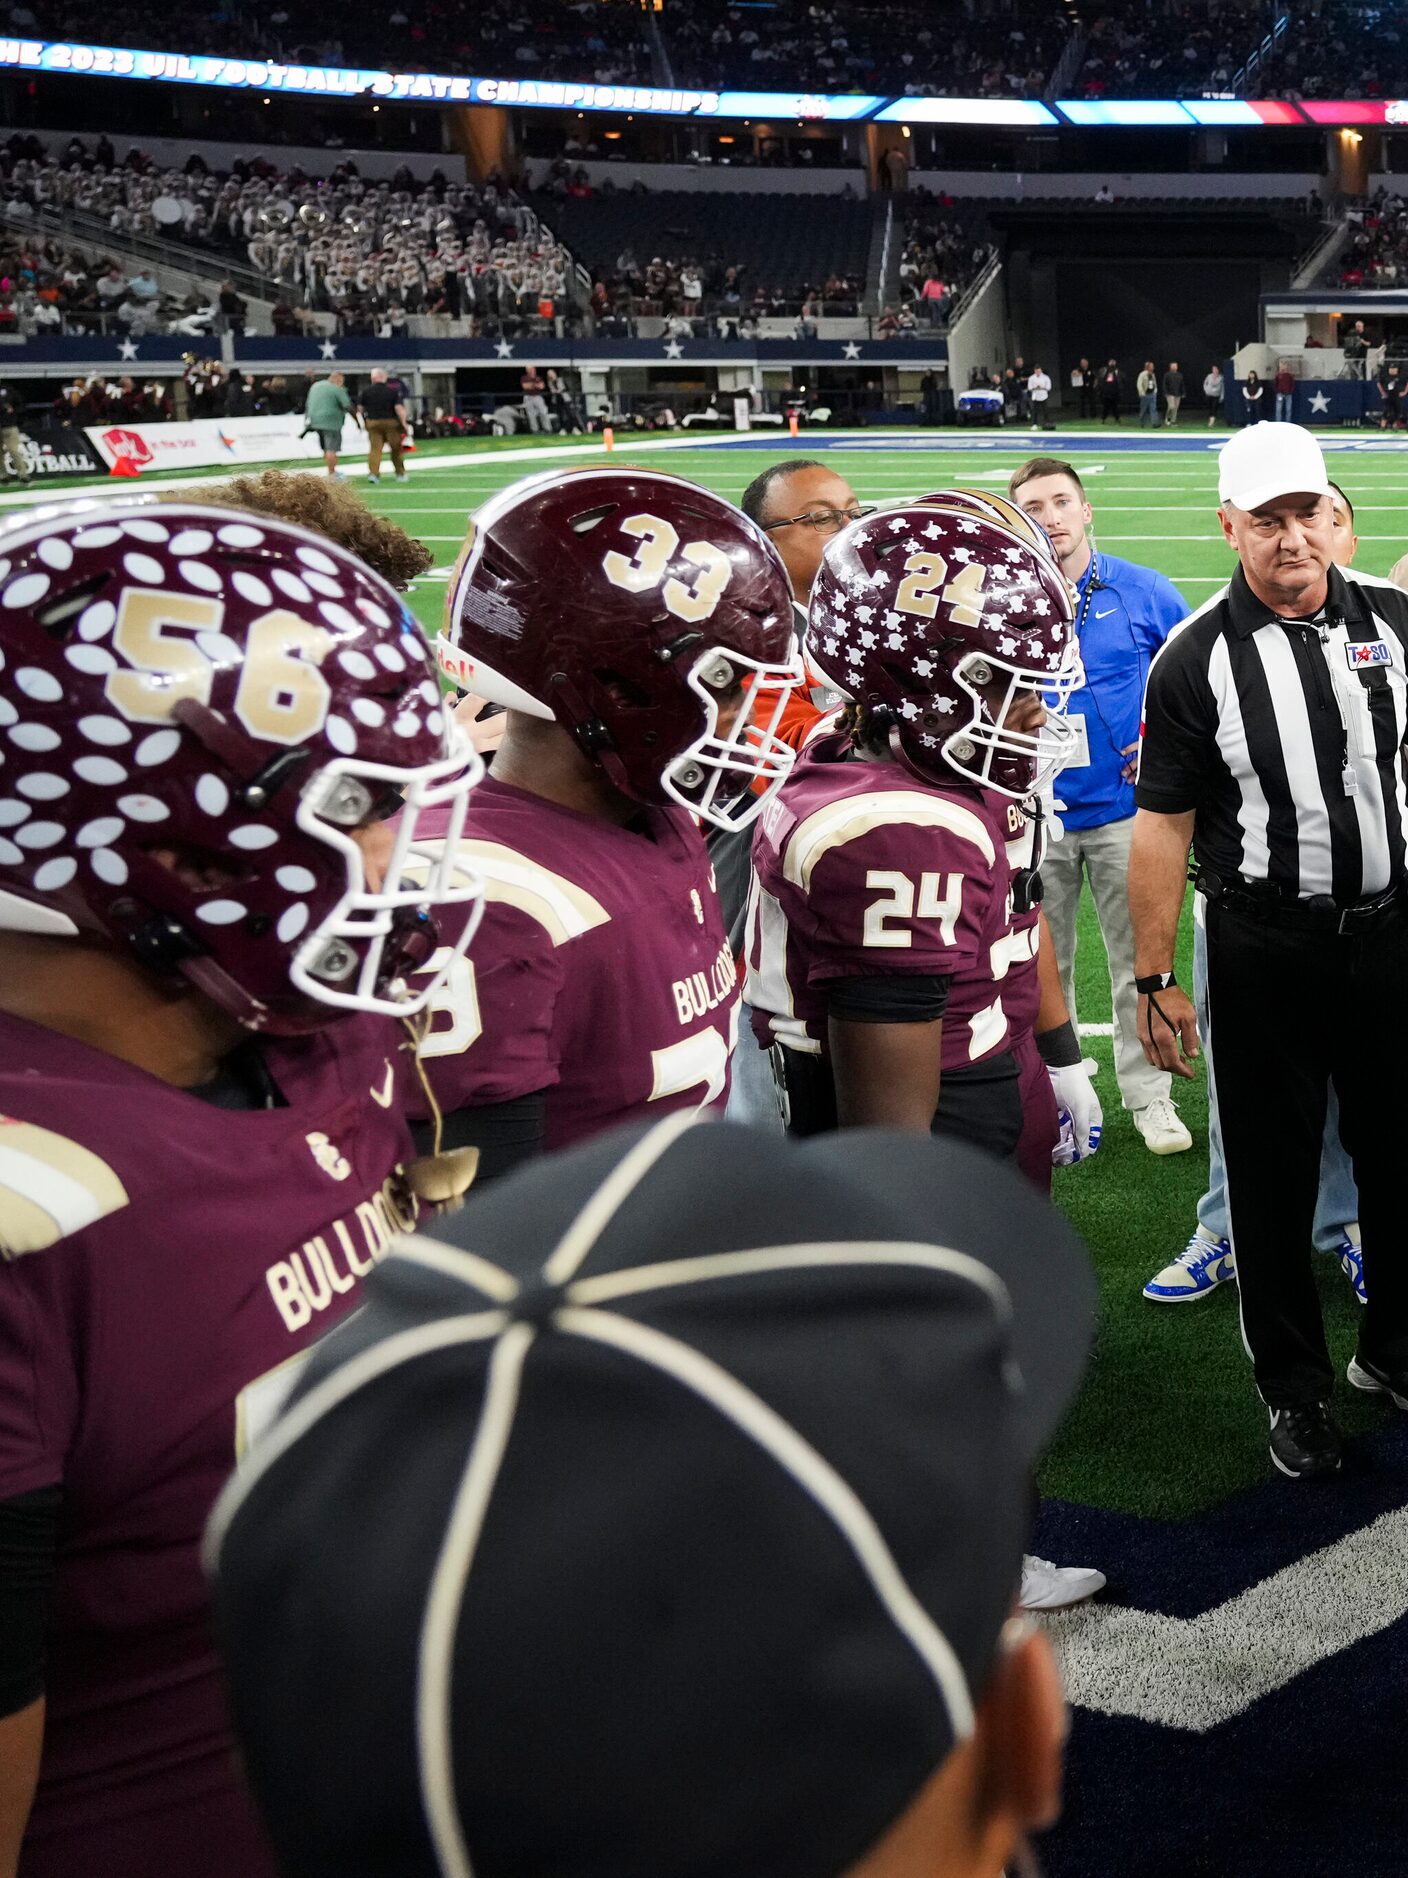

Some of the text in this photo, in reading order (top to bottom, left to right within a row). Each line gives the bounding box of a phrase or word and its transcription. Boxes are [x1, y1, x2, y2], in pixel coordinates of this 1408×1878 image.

[49, 45, 134, 74] 2023
[142, 56, 197, 80] UIL
[203, 60, 366, 94] FOOTBALL
[370, 73, 471, 100] STATE
[476, 79, 719, 113] CHAMPIONSHIPS
[602, 512, 733, 623] 33
[893, 550, 988, 629] 24
[94, 583, 336, 746] 56
[862, 869, 965, 948] 24
